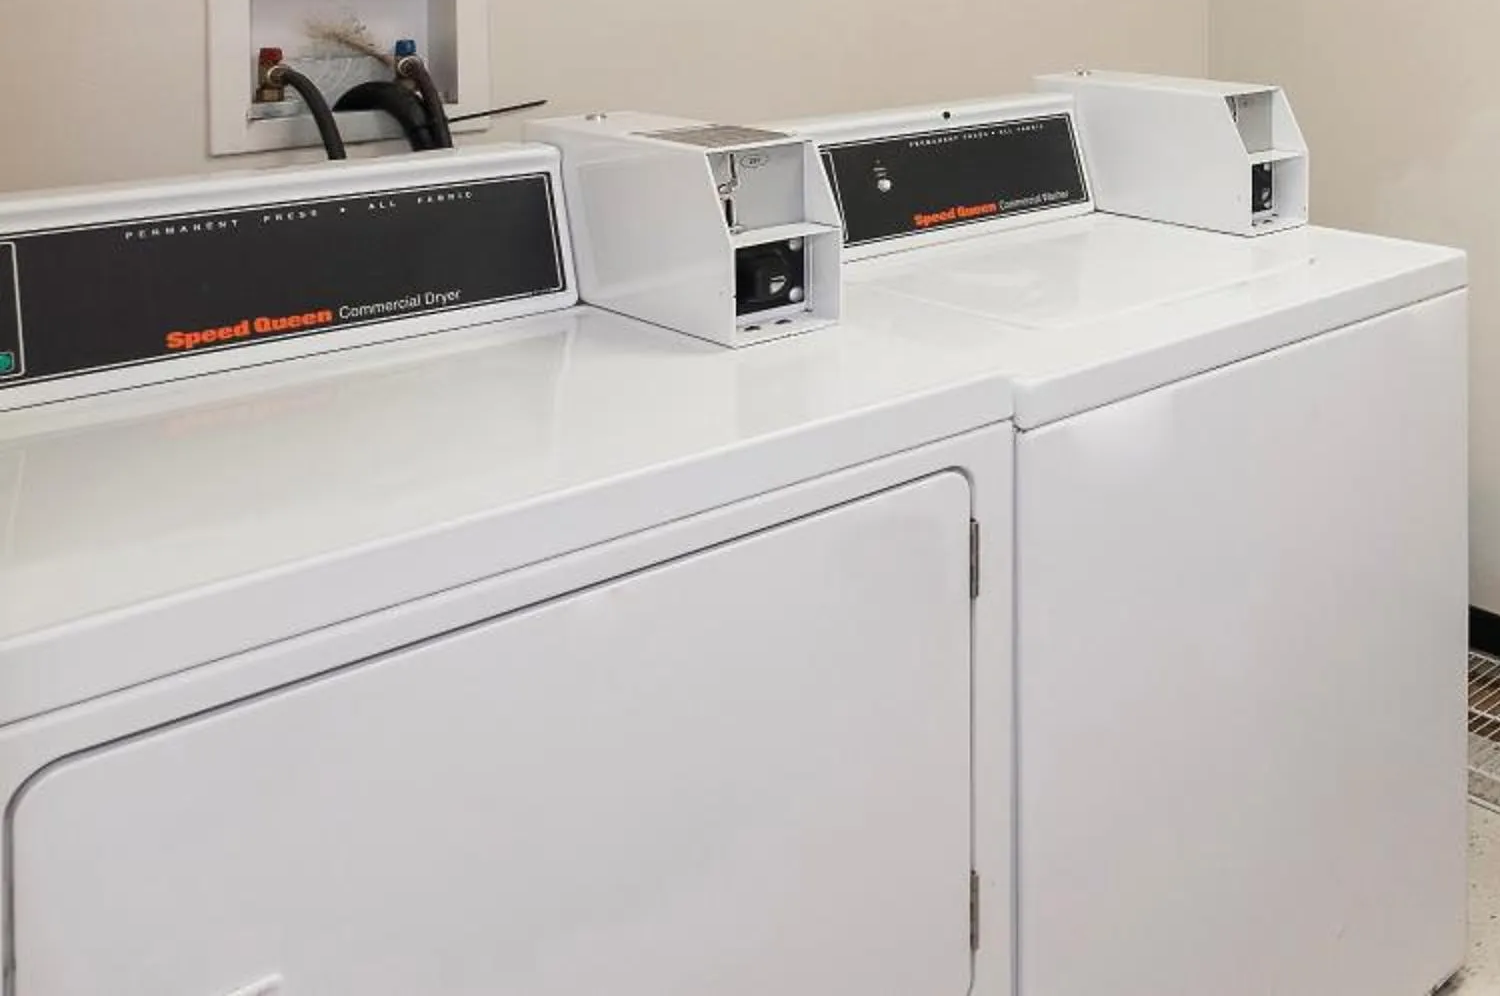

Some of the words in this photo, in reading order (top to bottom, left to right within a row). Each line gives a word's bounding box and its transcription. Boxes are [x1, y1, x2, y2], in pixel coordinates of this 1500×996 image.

[125, 219, 238, 240] PERMANENT
[263, 208, 318, 224] PRESS
[368, 200, 396, 210] ALL
[914, 207, 957, 227] Speed
[957, 203, 997, 218] Queen
[165, 320, 250, 350] Speed
[254, 308, 334, 333] Queen
[339, 293, 421, 320] Commercial
[425, 289, 462, 307] Dryer
